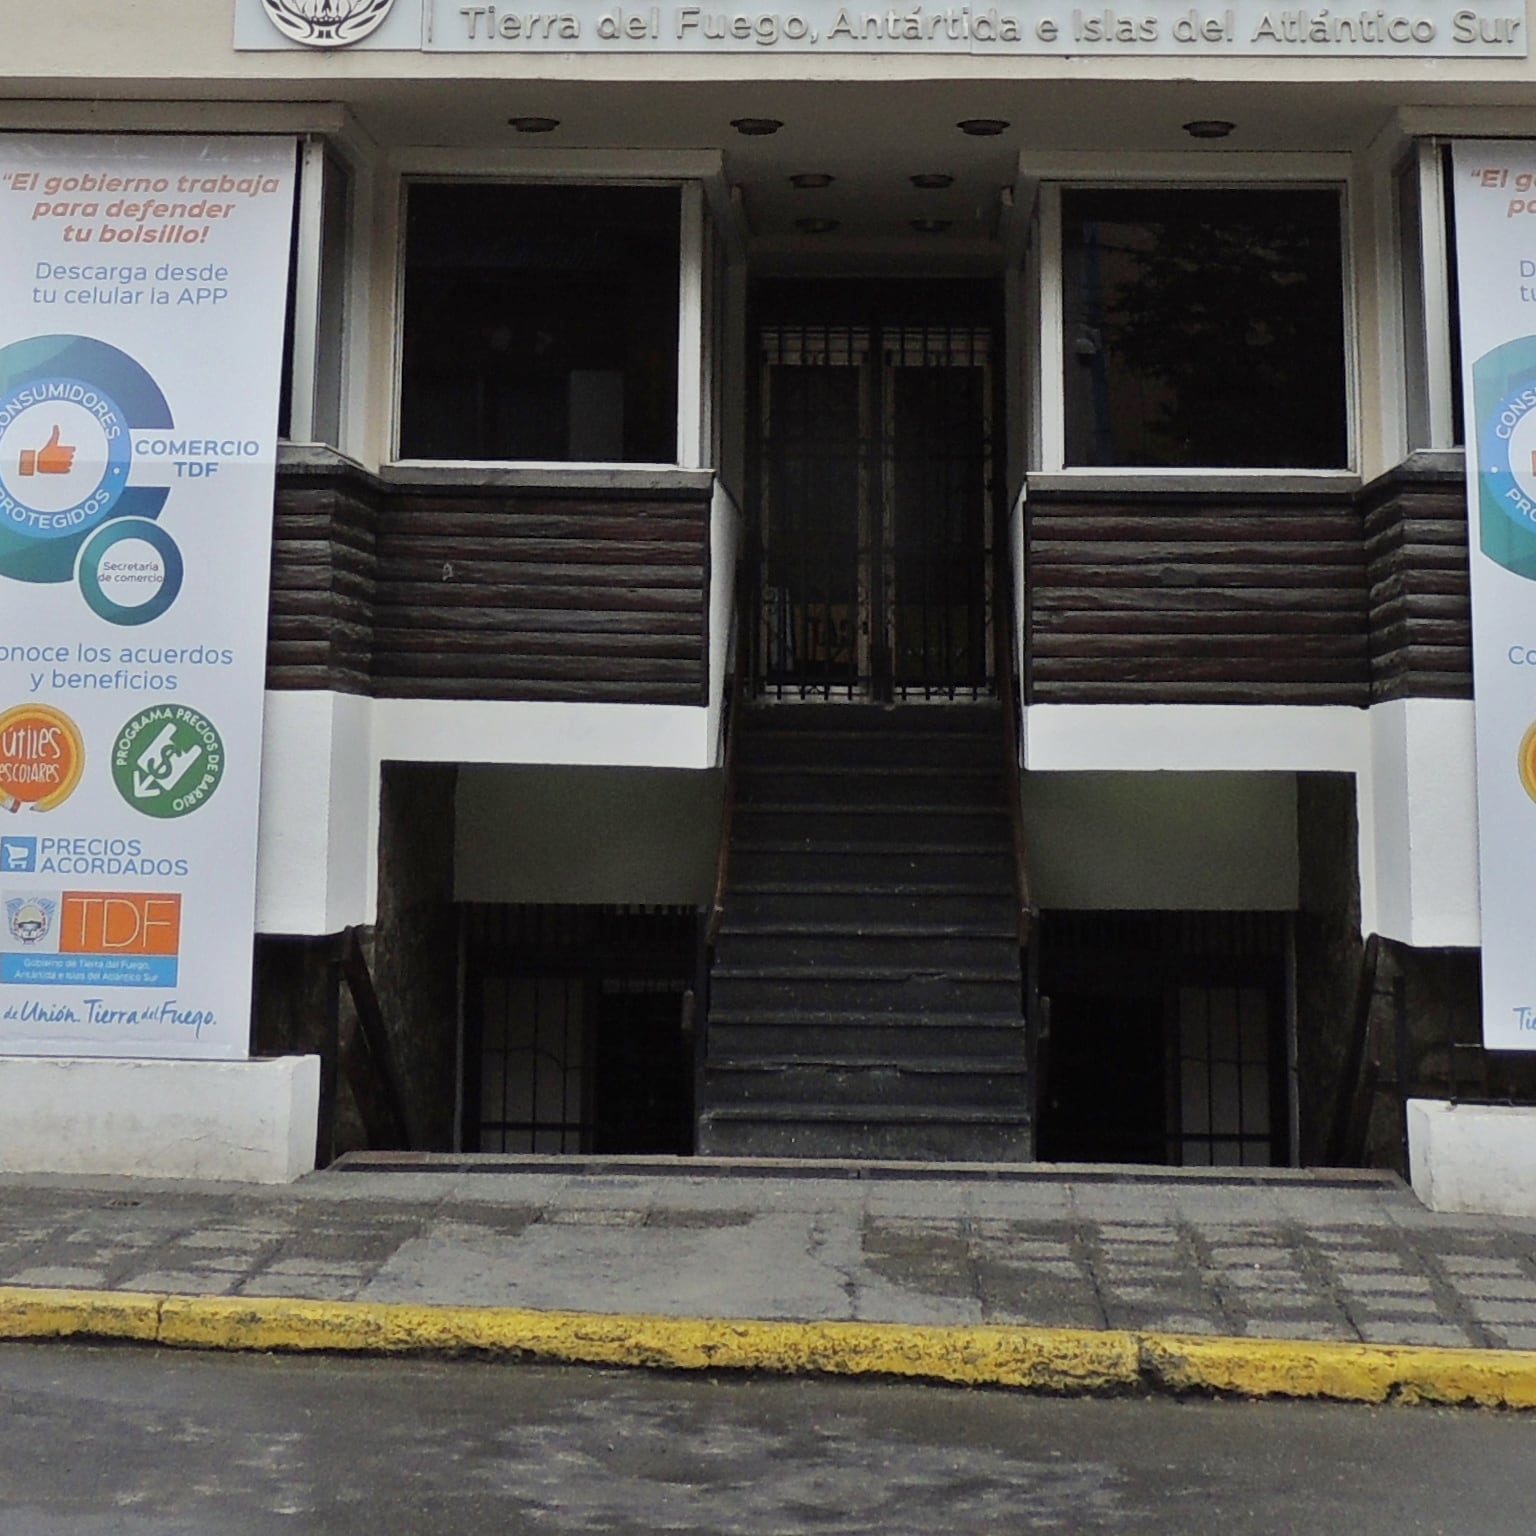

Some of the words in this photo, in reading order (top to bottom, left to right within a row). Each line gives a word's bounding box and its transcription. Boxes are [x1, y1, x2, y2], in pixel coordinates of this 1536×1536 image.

[462, 6, 580, 39] Tierra
[598, 6, 659, 40] del
[676, 7, 817, 46] Fuego,
[828, 6, 1021, 43] Antártida
[1036, 18, 1058, 43] e
[1073, 11, 1157, 43] Islas
[1173, 11, 1233, 43] del
[1251, 9, 1436, 44] Atlántico
[1453, 12, 1521, 44] Sur
[43, 174, 168, 197] gobierno
[176, 175, 279, 198] trabaja
[32, 200, 98, 221] para
[105, 199, 235, 222] defender
[63, 225, 92, 243] tu
[99, 225, 210, 244] bolsillo!
[36, 263, 147, 284] Descarga
[154, 264, 228, 282] desde
[33, 287, 56, 303] tu
[64, 287, 143, 304] celular
[150, 287, 169, 304] la
[177, 288, 228, 304] APP
[136, 440, 259, 456] COMERCIO
[173, 462, 219, 477] TDF
[98, 573, 111, 583] de
[114, 574, 163, 583] comercio
[78, 644, 111, 664] los
[119, 645, 232, 665] acuerdos
[29, 672, 44, 692] y
[51, 669, 177, 690] beneficios
[116, 708, 172, 766] PROGRAMA
[177, 708, 218, 751] PRECIOS
[209, 753, 219, 771] DE
[172, 774, 215, 811] BARRIO
[41, 838, 141, 856] PRECIOS
[39, 858, 188, 876] ACORDADOS
[68, 898, 175, 947] TDF
[4, 1006, 17, 1018] de
[84, 999, 140, 1024] Tierra
[142, 1006, 159, 1021] del
